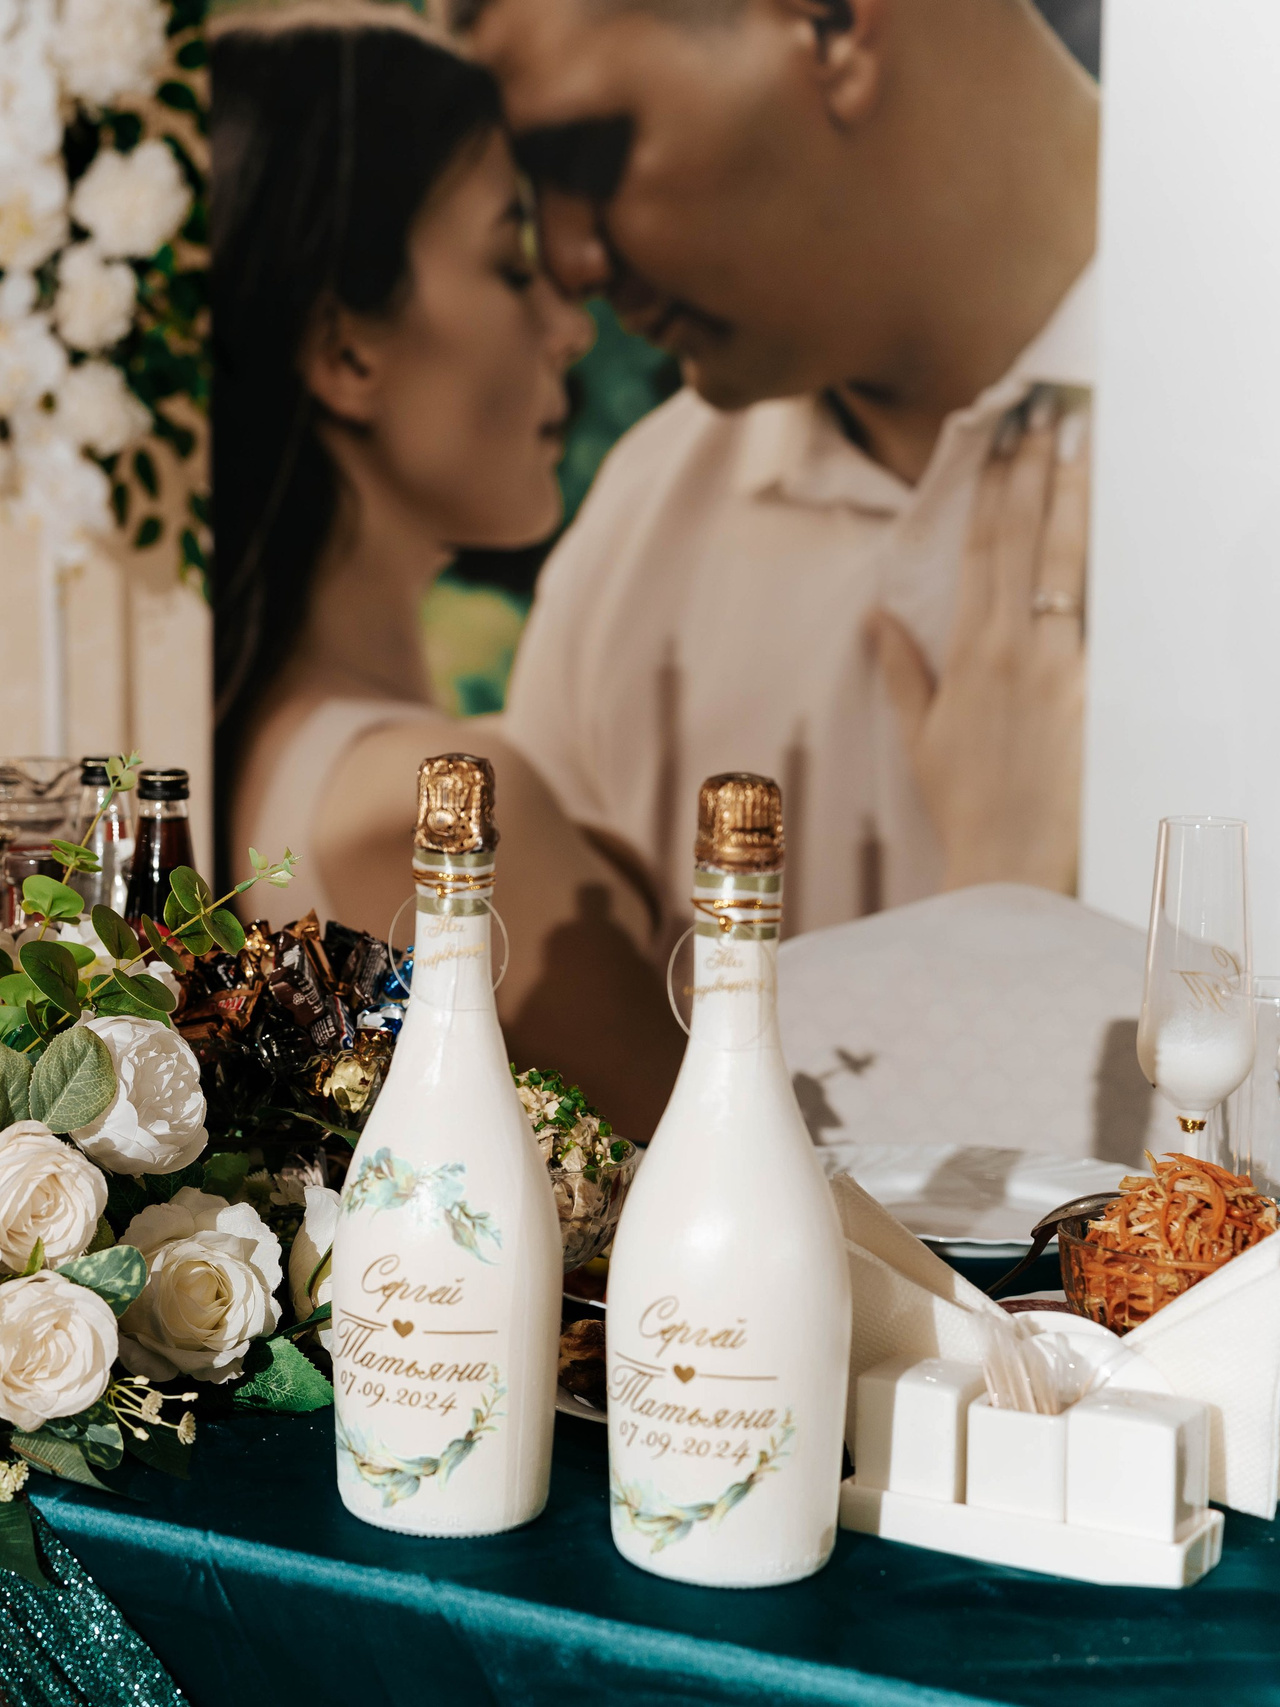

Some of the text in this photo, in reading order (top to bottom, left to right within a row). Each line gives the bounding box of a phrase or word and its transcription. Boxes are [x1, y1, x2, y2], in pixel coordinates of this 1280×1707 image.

[361, 1253, 466, 1313] Сергей
[335, 1317, 490, 1383] Татьяна
[638, 1295, 747, 1358] Сергей
[340, 1369, 457, 1417] 07.09.2024
[609, 1364, 778, 1430] Татьяна
[620, 1420, 751, 1467] 07.09.2024
